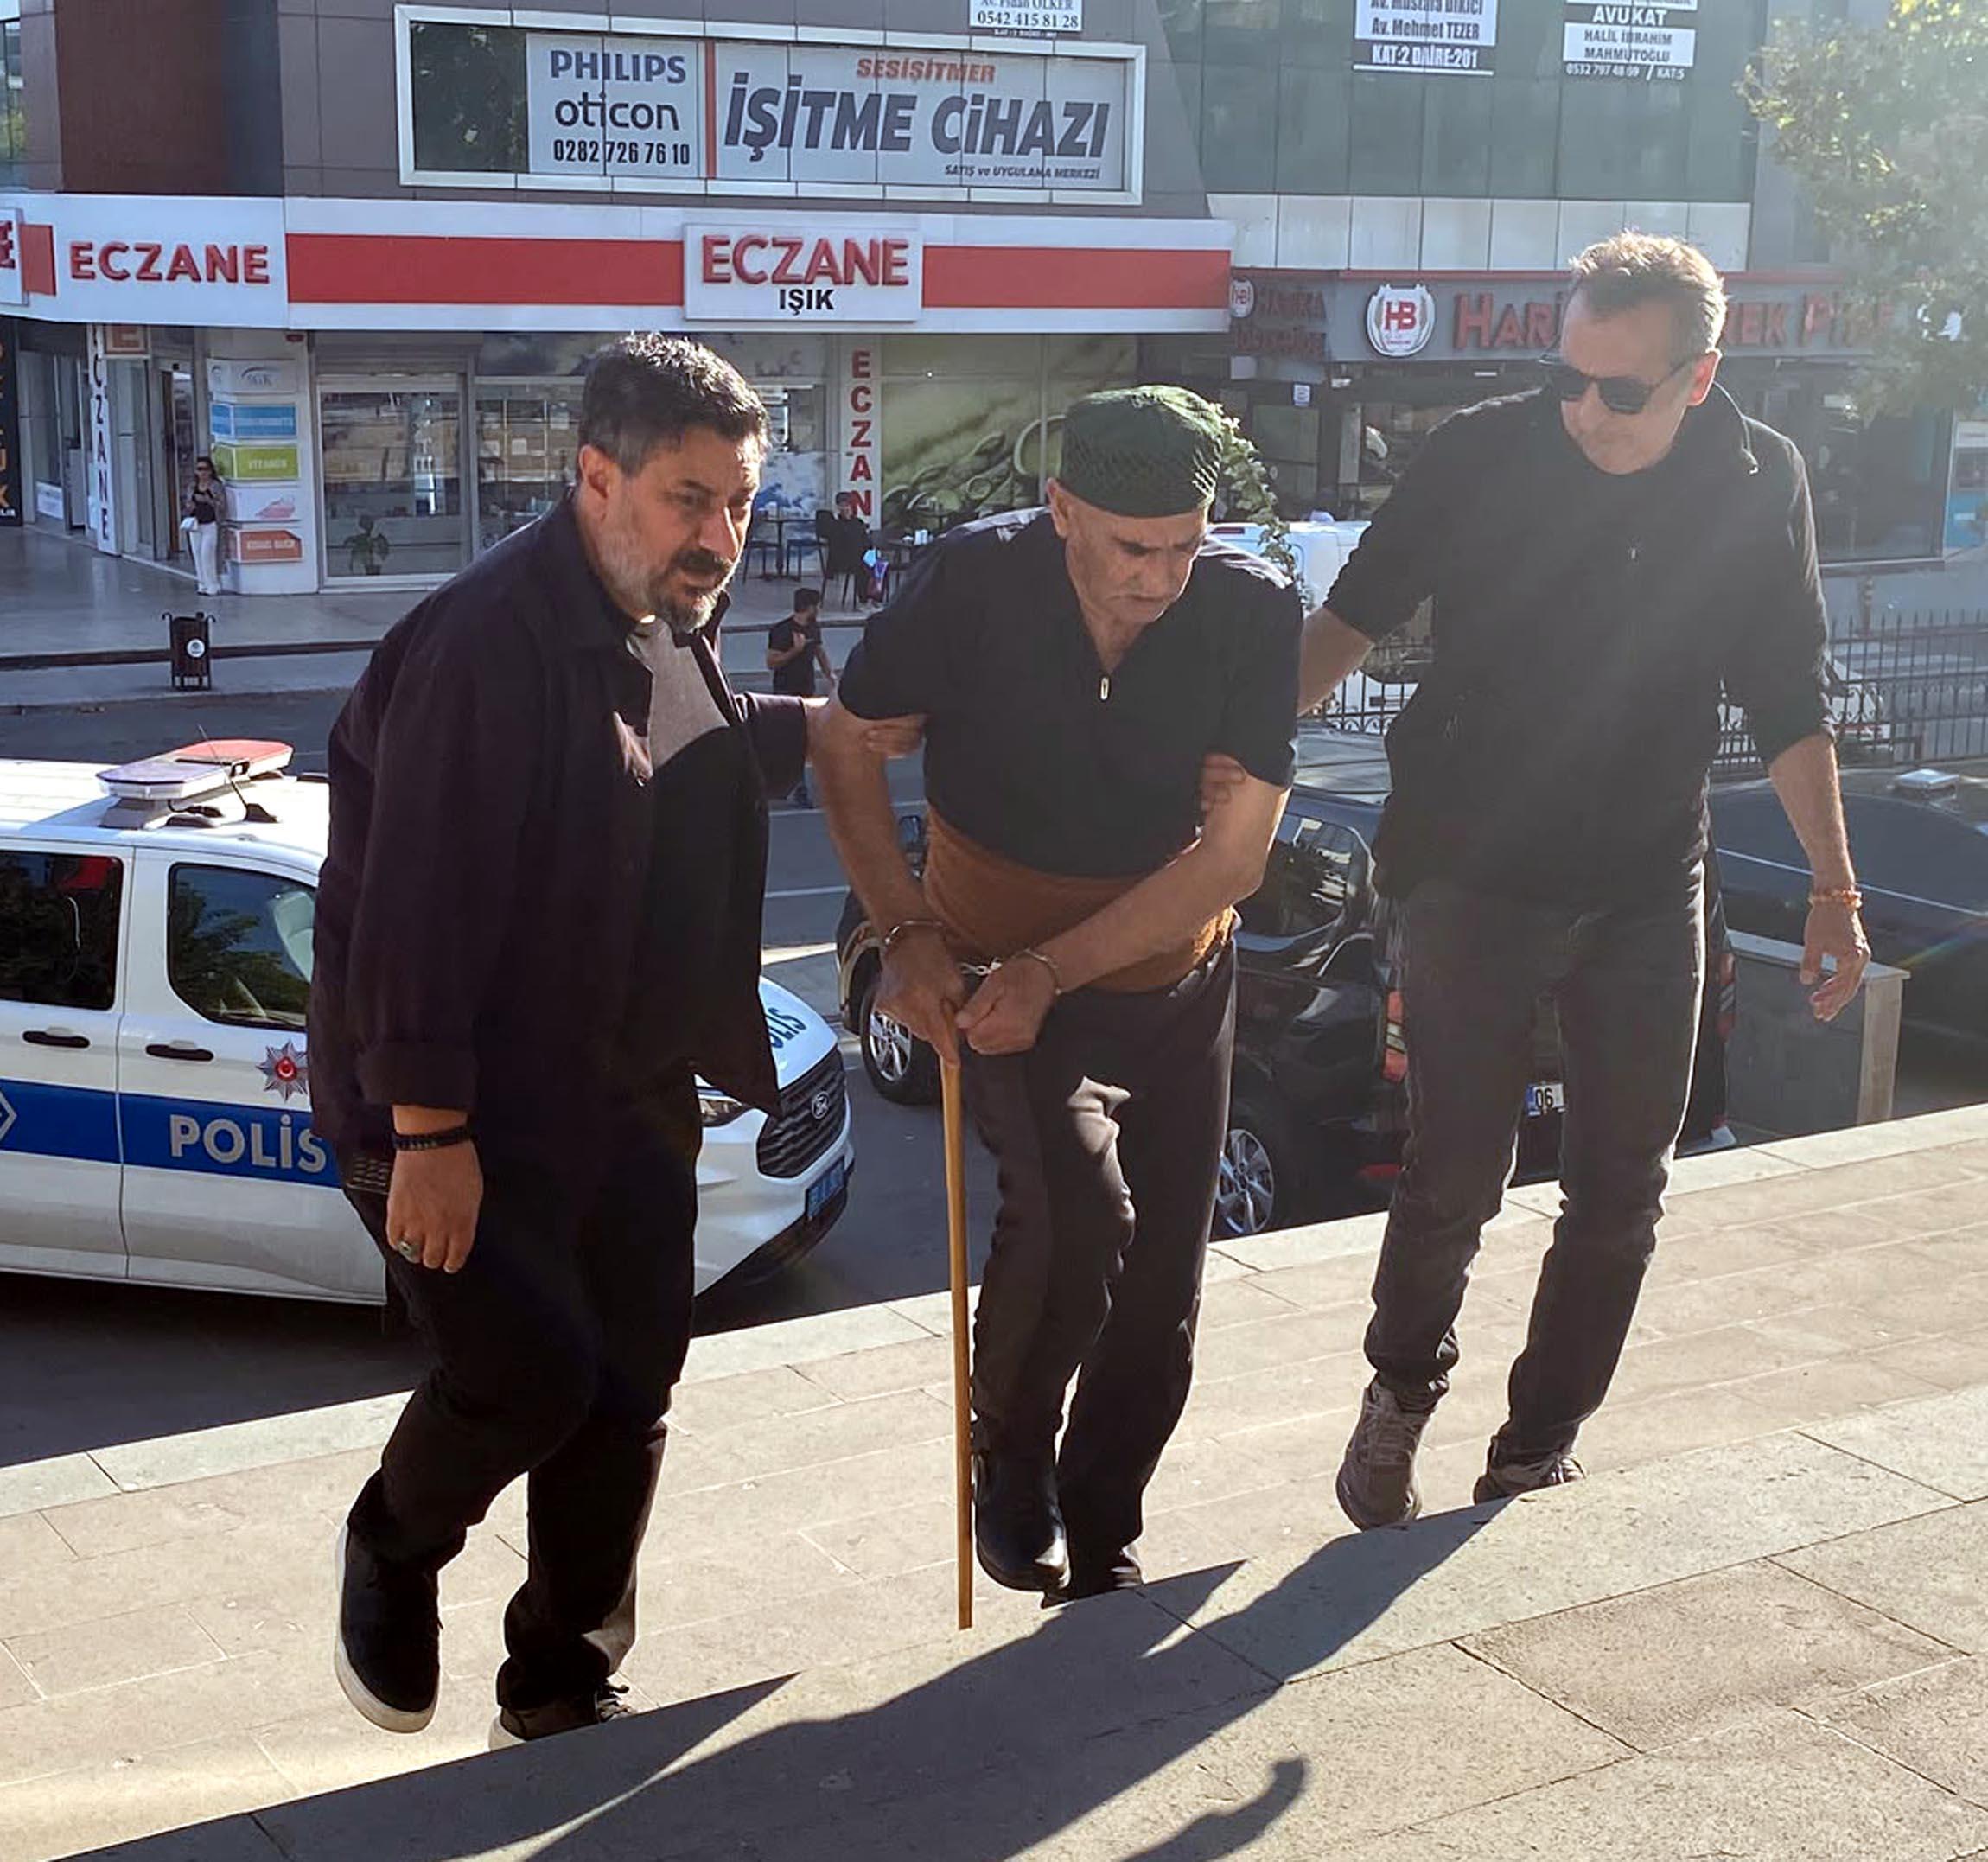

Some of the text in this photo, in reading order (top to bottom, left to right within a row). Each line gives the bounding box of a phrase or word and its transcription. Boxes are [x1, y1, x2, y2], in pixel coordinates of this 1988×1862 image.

[978, 10, 1079, 29] 0542 415 81 28
[1372, 17, 1480, 40] Av. Mehmet TEZER
[1593, 5, 1668, 26] AVUKAT
[1584, 29, 1617, 43] HALİL
[551, 50, 686, 84] PHILIPS
[1584, 47, 1671, 62] MAHMUTOĞLU
[857, 58, 996, 84] SESİŞİTMER
[555, 91, 679, 131] oticon
[724, 73, 917, 162] İŞİTME
[553, 139, 690, 165] 0282 726 76 10
[945, 164, 1100, 179] SATIŞ ve UYGULAMA MERKEZİ
[69, 240, 271, 284] ECZANE
[702, 234, 909, 286] ECZANE
[779, 289, 835, 316] IŞIK
[1385, 301, 1417, 330] HB
[849, 349, 873, 517] ECZAN
[1535, 1087, 1554, 1108] 06
[169, 1113, 327, 1174] POLİS
